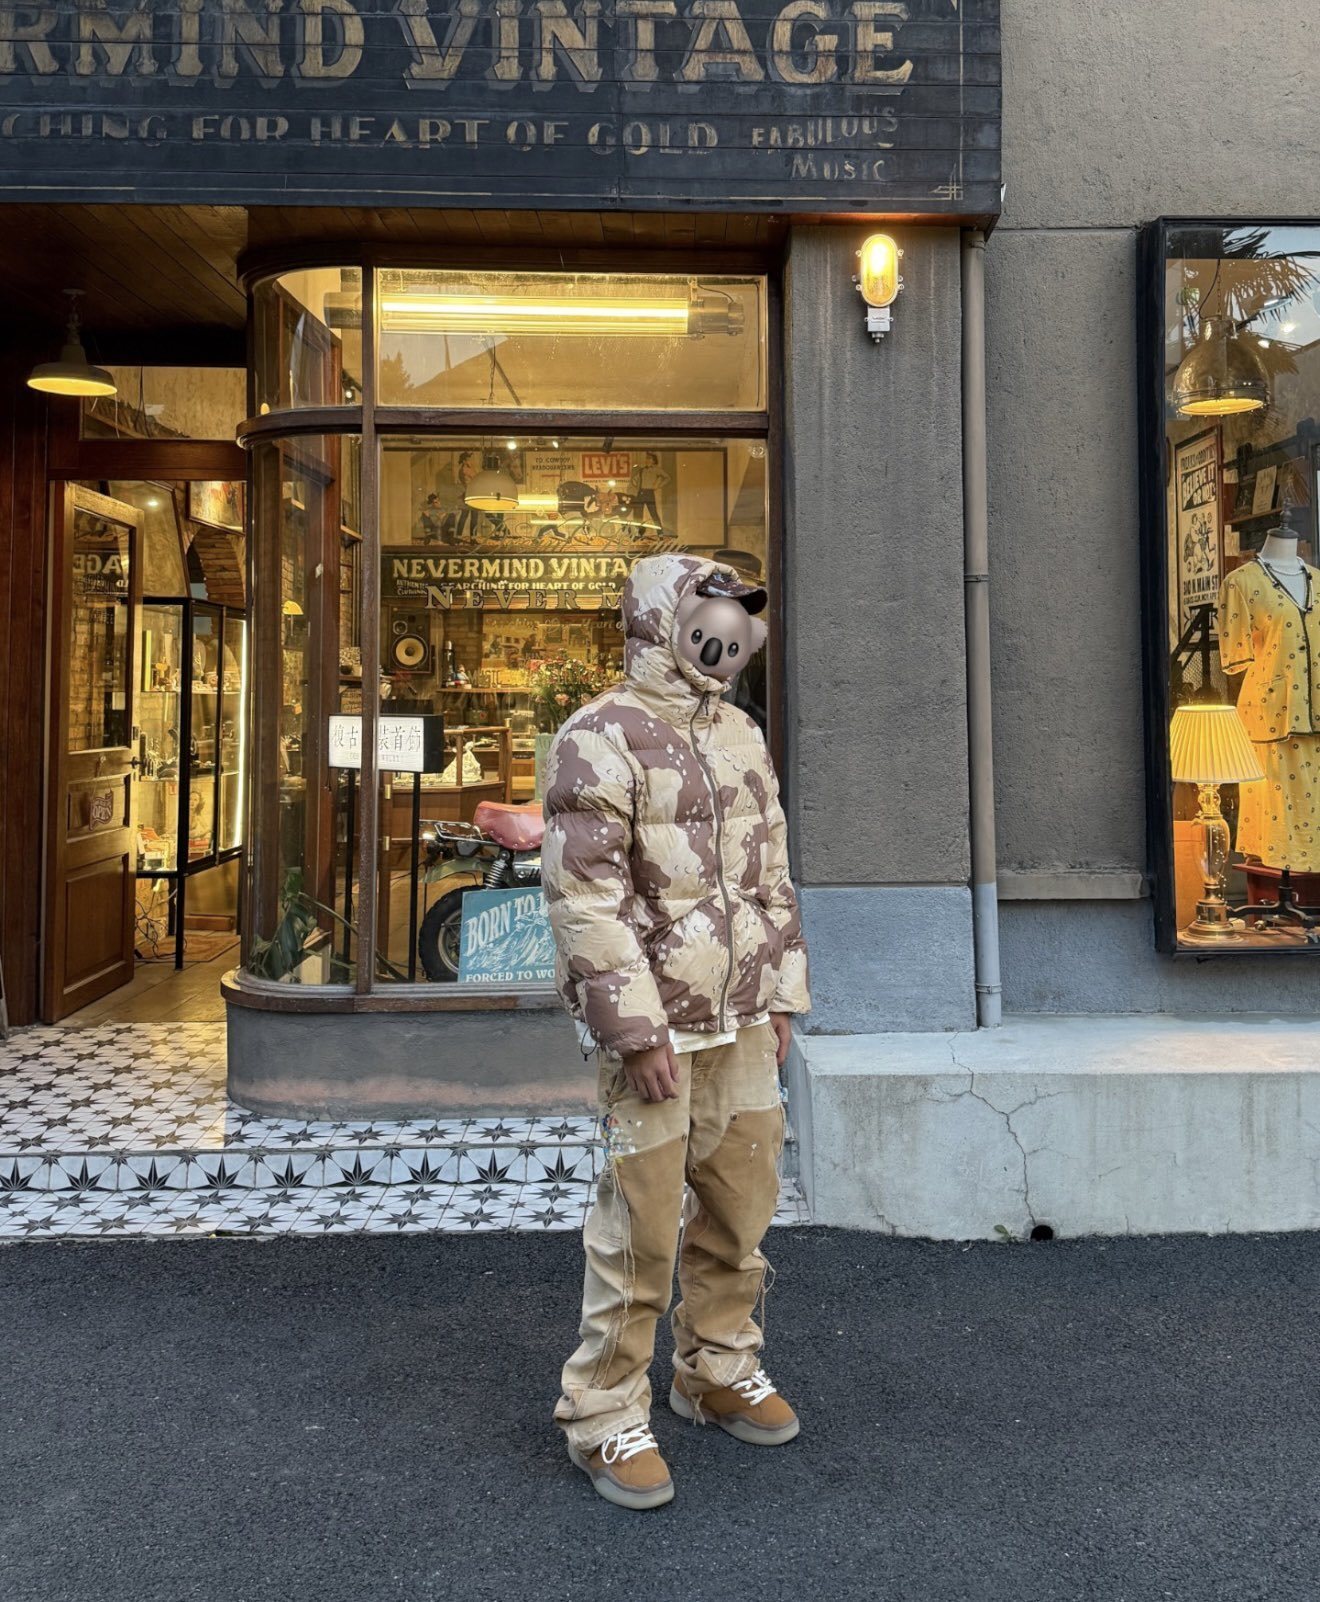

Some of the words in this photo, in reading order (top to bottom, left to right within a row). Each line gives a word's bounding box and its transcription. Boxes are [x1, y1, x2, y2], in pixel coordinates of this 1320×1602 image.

[400, 0, 914, 86] VINTAGE
[192, 116, 289, 143] FOR
[310, 116, 490, 149] HEART
[506, 120, 569, 152] OF
[587, 122, 719, 155] GOLD
[584, 456, 629, 475] LEVI'S
[393, 558, 545, 578] NEVERMIND
[549, 557, 639, 579] VINTA
[425, 585, 580, 610] NEVER
[464, 901, 512, 957] BORN
[465, 972, 513, 983] FORCED
[517, 970, 533, 980] TO
